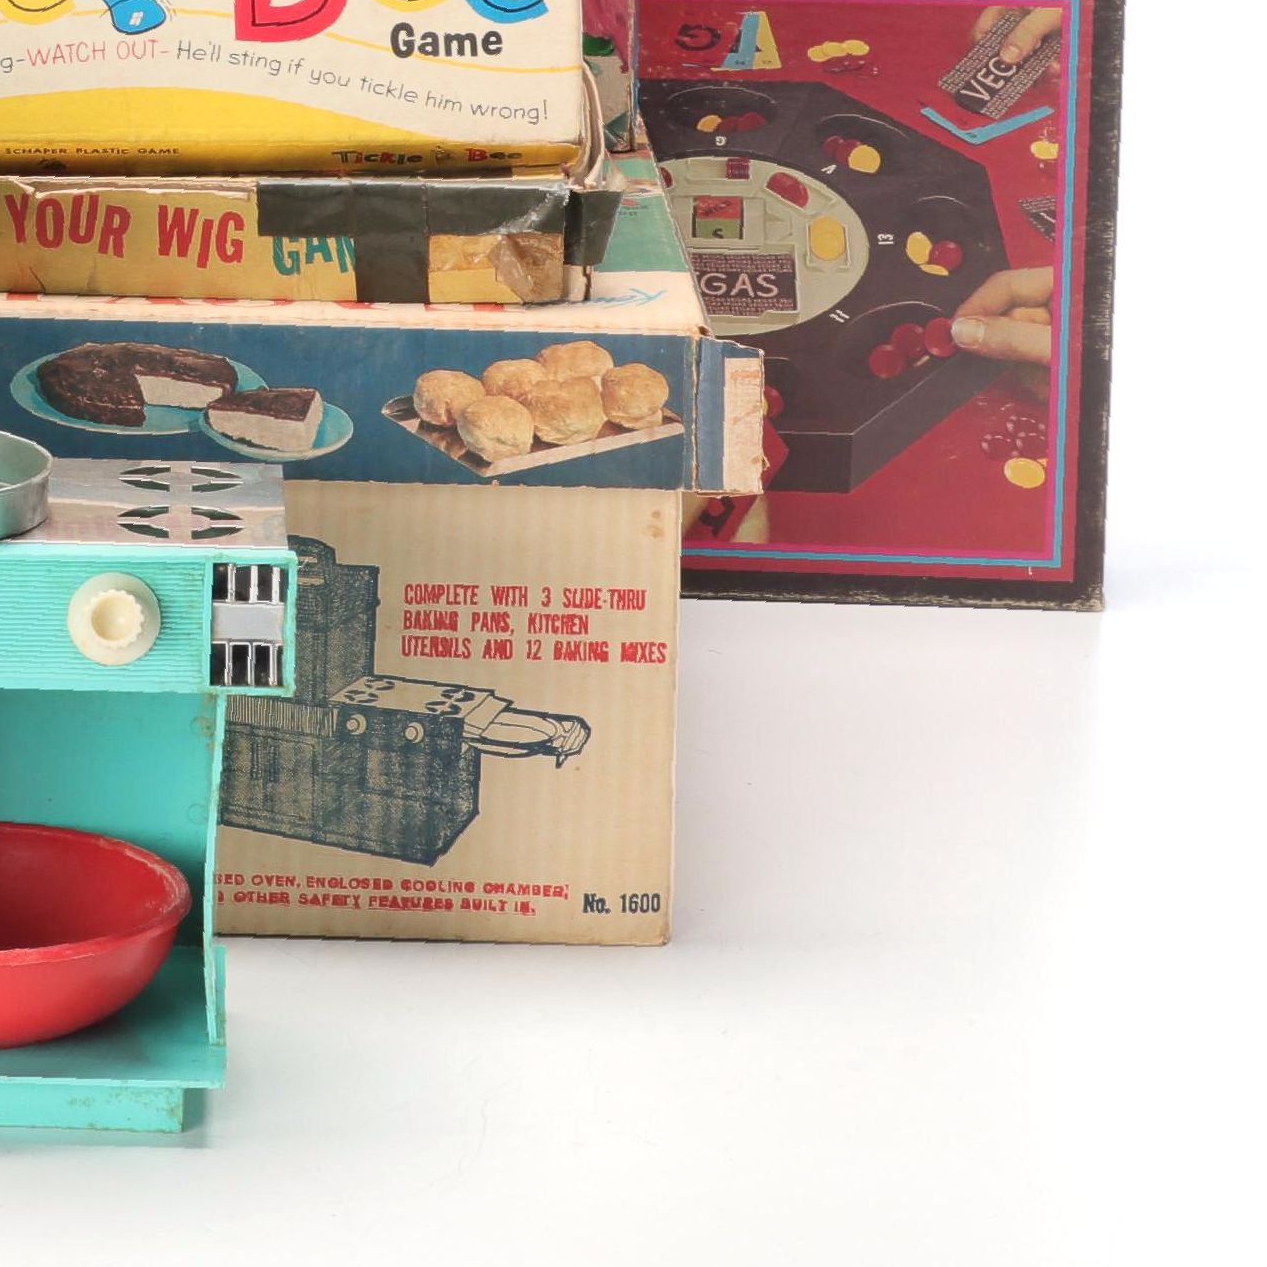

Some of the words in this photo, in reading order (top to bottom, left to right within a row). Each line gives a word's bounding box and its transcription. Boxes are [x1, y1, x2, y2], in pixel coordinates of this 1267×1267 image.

[390, 22, 503, 59] Game
[176, 41, 221, 64] He'll
[228, 49, 281, 76] sting
[287, 56, 305, 76] if
[308, 66, 350, 88] you
[360, 76, 419, 104] tickle
[425, 90, 463, 112] him
[470, 99, 549, 126] wrong!
[960, 56, 1017, 101] VEG
[5, 147, 68, 155] SCHAPER
[75, 147, 129, 156] PLASTIC
[138, 147, 180, 155] GAME
[332, 150, 424, 165] Tickle
[465, 148, 523, 162] Bee
[4, 192, 132, 259] YOUR
[157, 204, 245, 269] WIG
[698, 272, 779, 297] GAS
[404, 583, 480, 606] COMPLETE
[490, 585, 528, 607] WITH
[541, 586, 551, 608] 3
[562, 587, 647, 610] SLIDE-THRU
[403, 610, 459, 632] BAKING
[470, 612, 515, 636] PANS,
[527, 613, 589, 635] KITCHEN
[401, 636, 472, 659] UTENSILS
[482, 639, 513, 660] AND
[526, 639, 542, 660] 12
[553, 641, 609, 662] BAKING
[620, 641, 668, 664] MIXES
[251, 874, 301, 888] OVEN,
[306, 876, 393, 891] ENCLOSED
[400, 878, 476, 893] COOLING
[234, 891, 291, 905] OTHER
[298, 893, 362, 910] SAFETY
[368, 895, 454, 911] FEATURES
[460, 897, 509, 912] BUILT
[583, 893, 611, 914] No.
[620, 893, 661, 914] 1600
